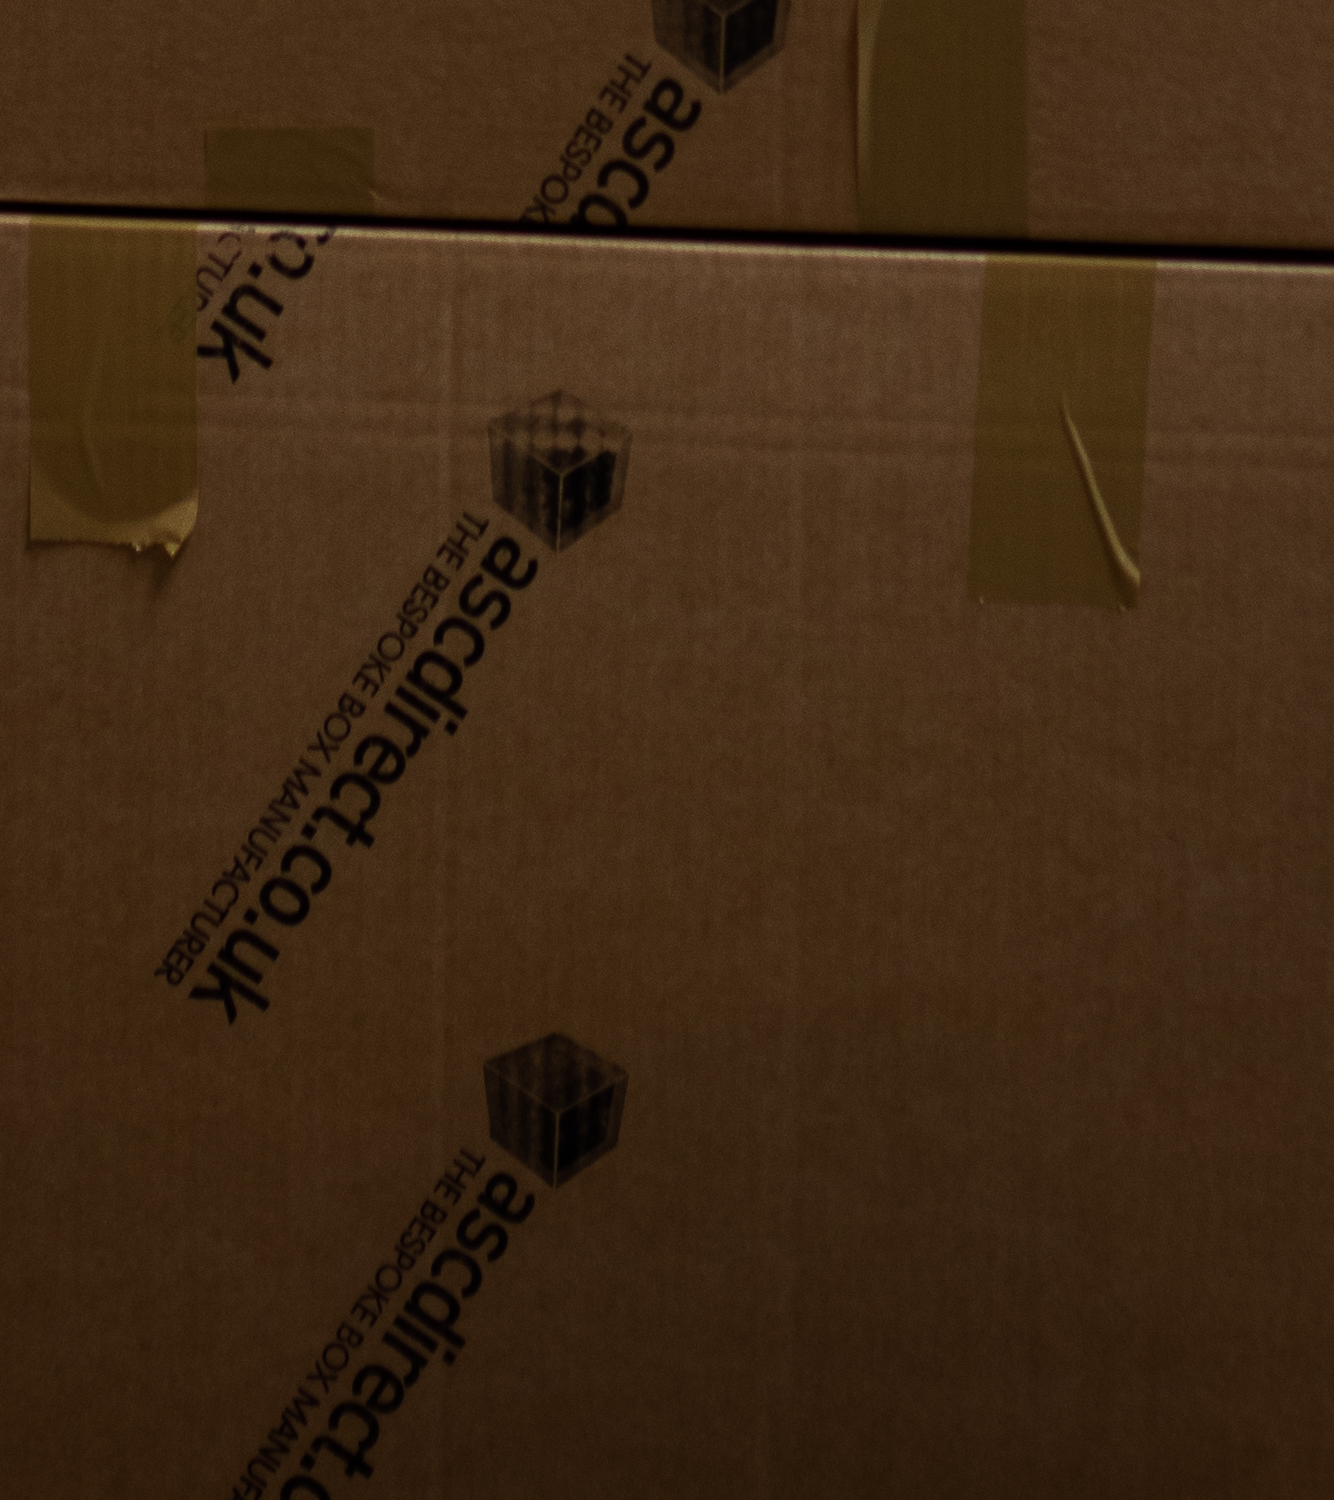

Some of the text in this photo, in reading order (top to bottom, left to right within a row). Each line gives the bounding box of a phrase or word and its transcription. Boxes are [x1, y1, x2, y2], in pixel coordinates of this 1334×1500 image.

[600, 53, 652, 113] THE
[153, 511, 489, 987] THE BESPOKE BOX MANUFACTURER
[188, 535, 538, 1026] ascdirect.co.uk
[434, 1148, 487, 1206] THE
[350, 1198, 449, 1327] BESPOKE
[307, 1321, 365, 1393] BOX
